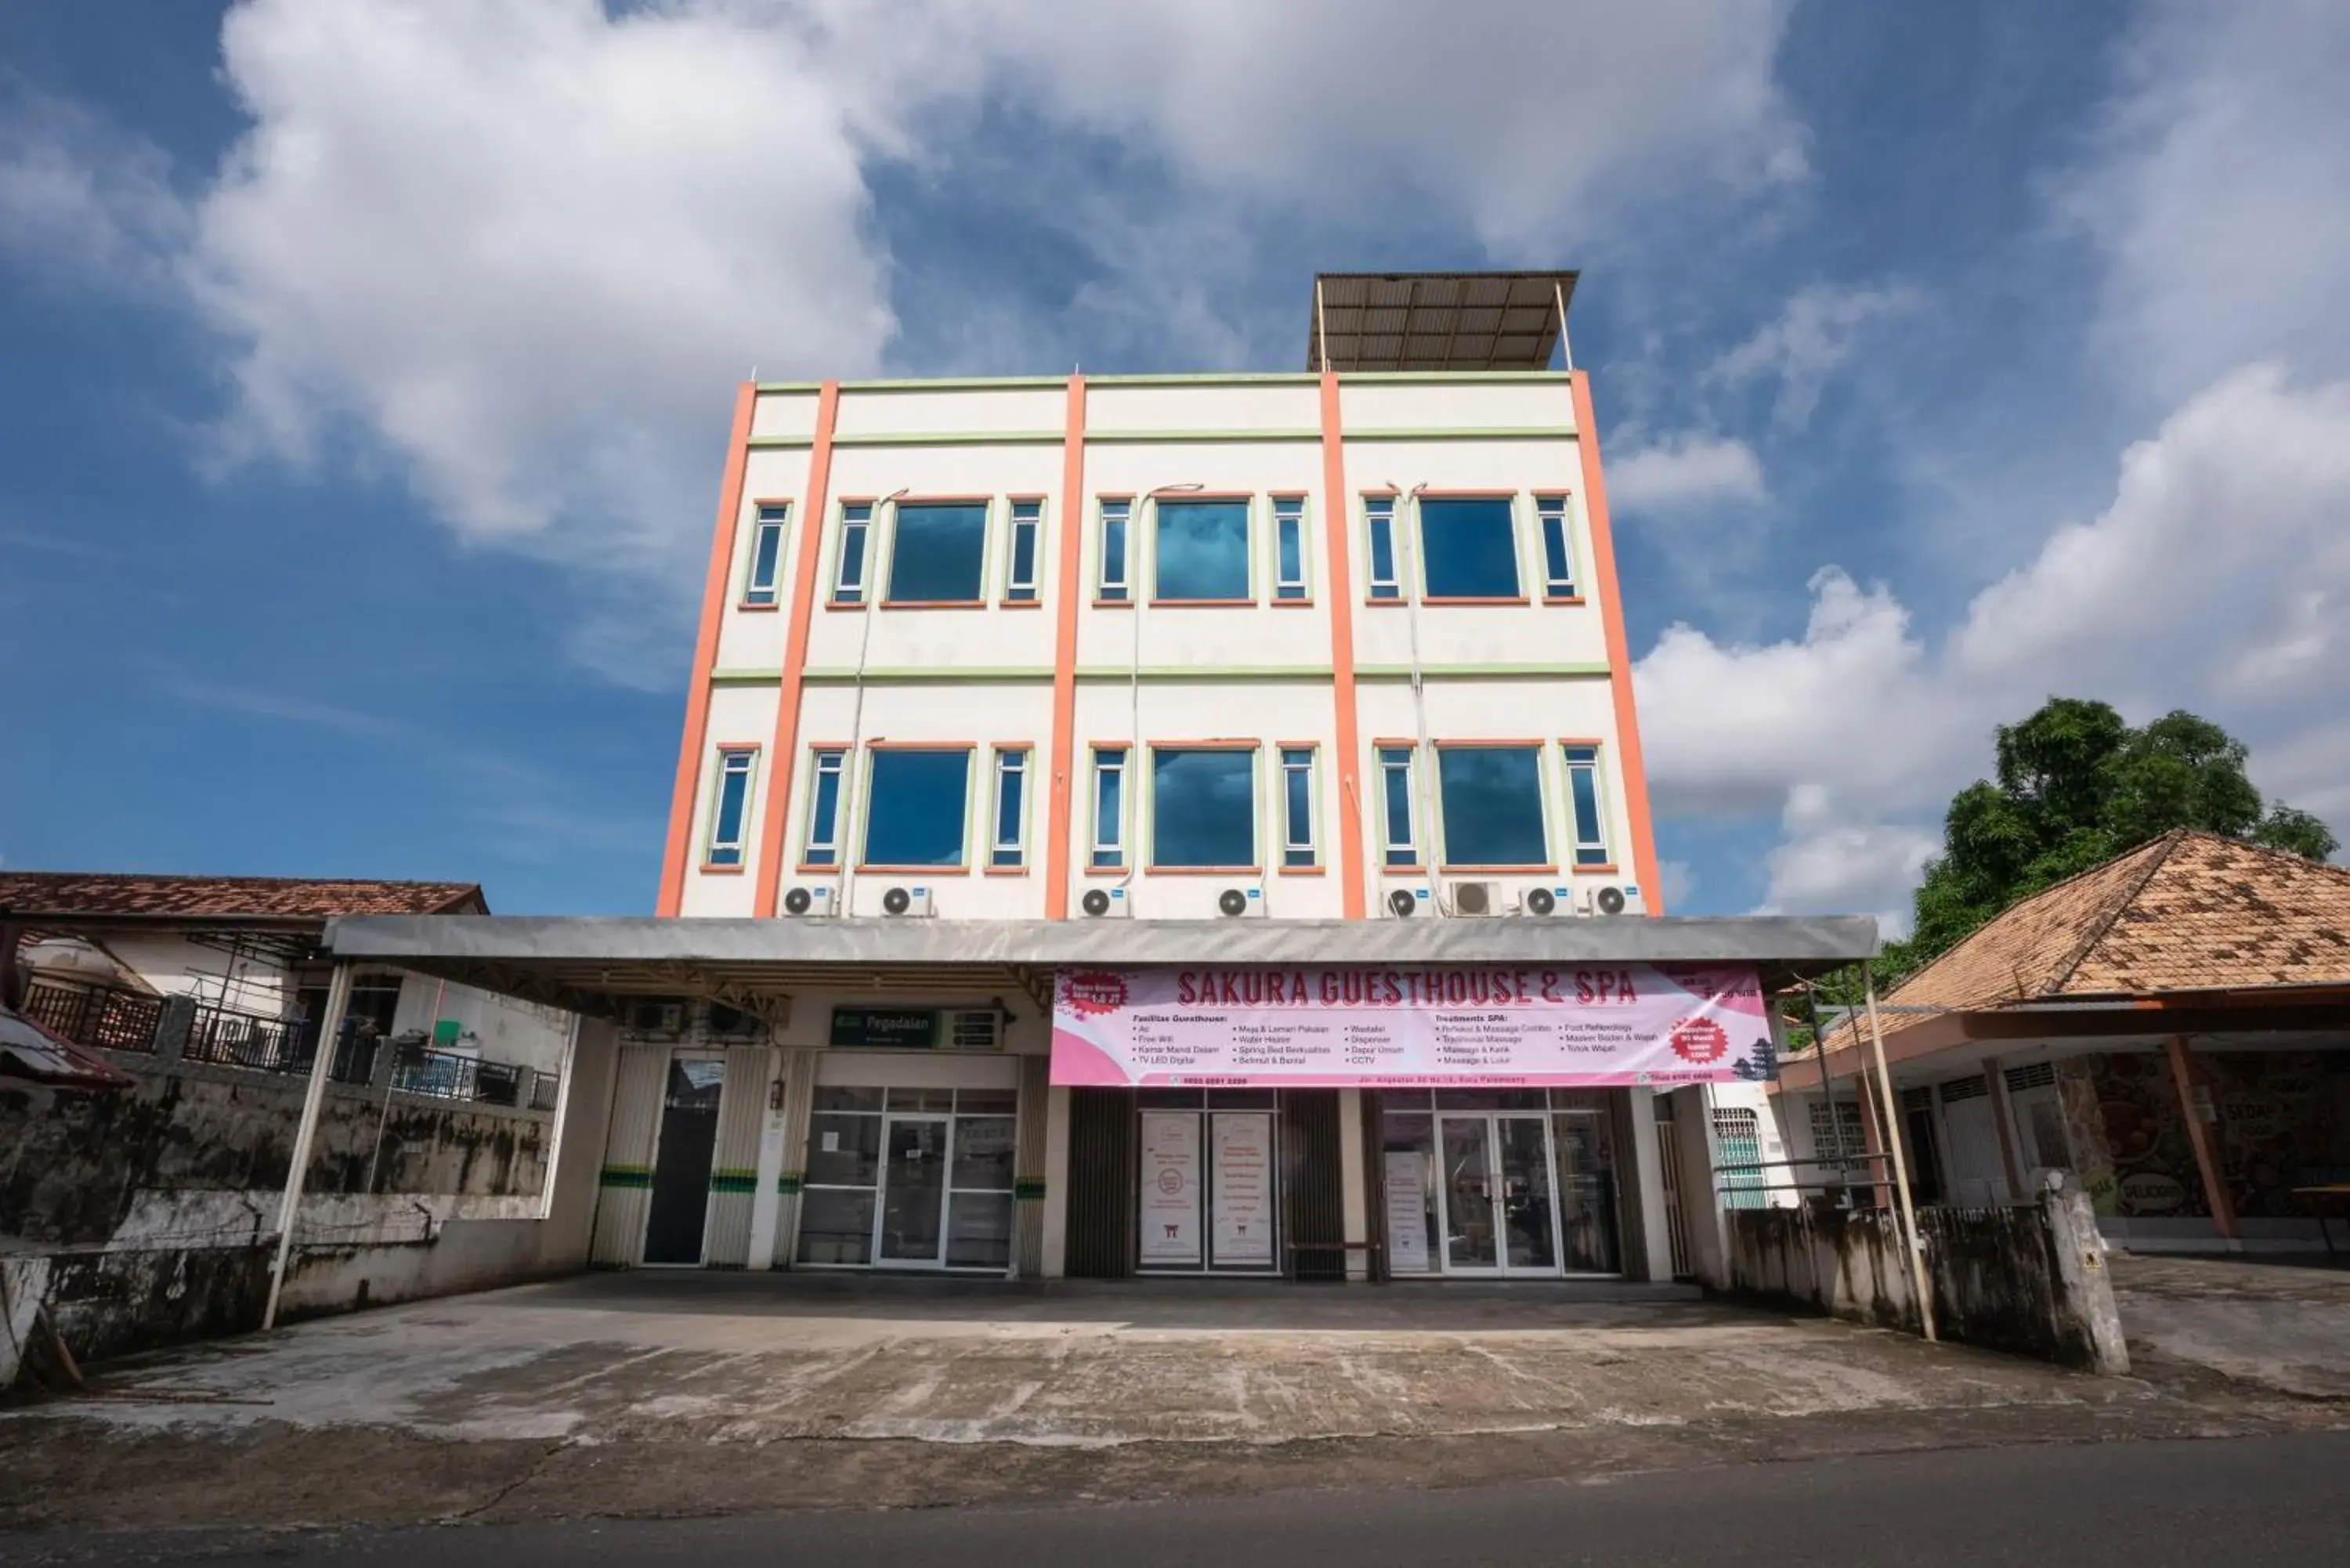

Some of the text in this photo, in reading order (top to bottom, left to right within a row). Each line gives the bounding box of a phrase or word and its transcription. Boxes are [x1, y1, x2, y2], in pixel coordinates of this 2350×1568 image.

[1177, 970, 1637, 1006] SAKURA GUESTHOUSE & SPA
